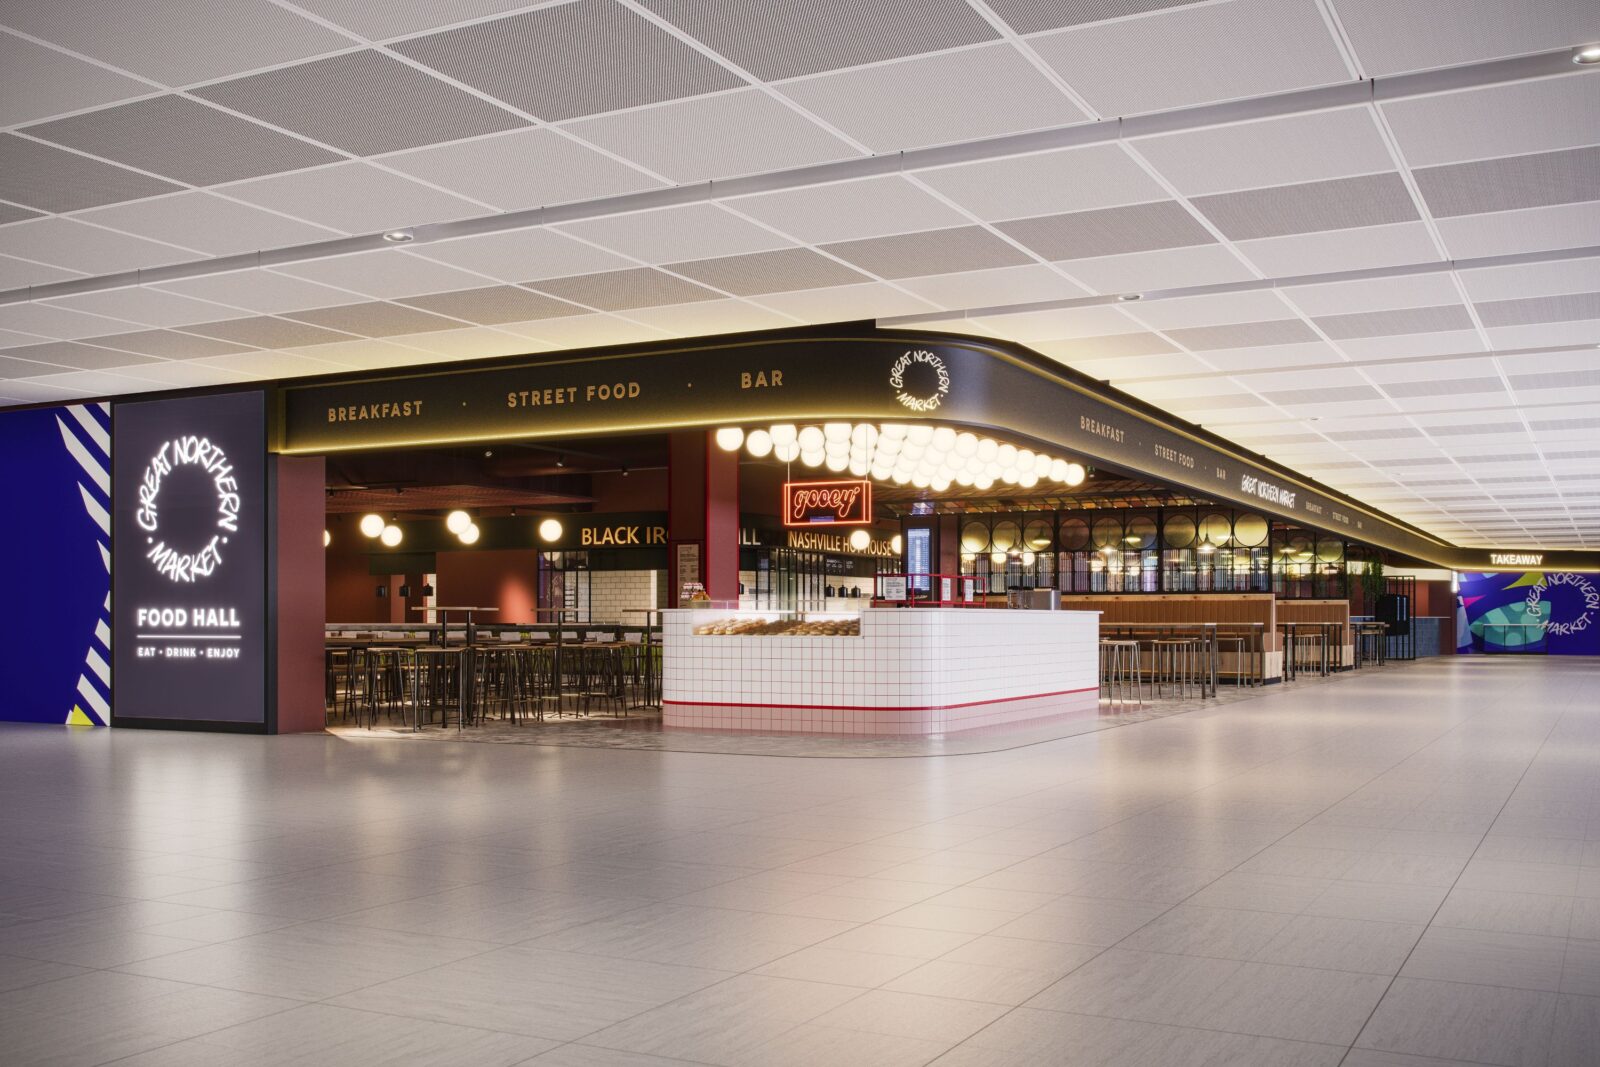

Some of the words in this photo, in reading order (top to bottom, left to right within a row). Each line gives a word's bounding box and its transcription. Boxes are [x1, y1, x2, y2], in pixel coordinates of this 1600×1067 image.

[890, 351, 912, 388] GREAT
[913, 350, 950, 393] NORTHERN
[328, 400, 423, 422] BREAKFAST
[507, 387, 577, 408] STREET
[586, 382, 641, 401] FOOD
[741, 369, 783, 389] BAR
[896, 393, 940, 411] MARKET
[1080, 415, 1124, 443] BREAKFAST
[1154, 444, 1177, 462] STREET
[1178, 453, 1194, 468] FOOD
[137, 441, 171, 531] GREAT
[174, 435, 240, 532] NORTHERN
[794, 486, 860, 518] gooey
[581, 526, 640, 545] BLACK
[646, 526, 669, 544] IR
[788, 531, 841, 551] NASHVILLE
[146, 535, 222, 582] MARKET
[1490, 553, 1543, 565] TAKEAWAY
[1526, 578, 1548, 617] GREAT
[1547, 572, 1600, 610] NORTHERN
[137, 608, 187, 627] FOOD
[193, 608, 240, 627] HALL
[1537, 612, 1592, 635] MARKET
[137, 647, 156, 658] EAT
[165, 647, 196, 658] DRINK
[206, 647, 240, 659] ENJOY
